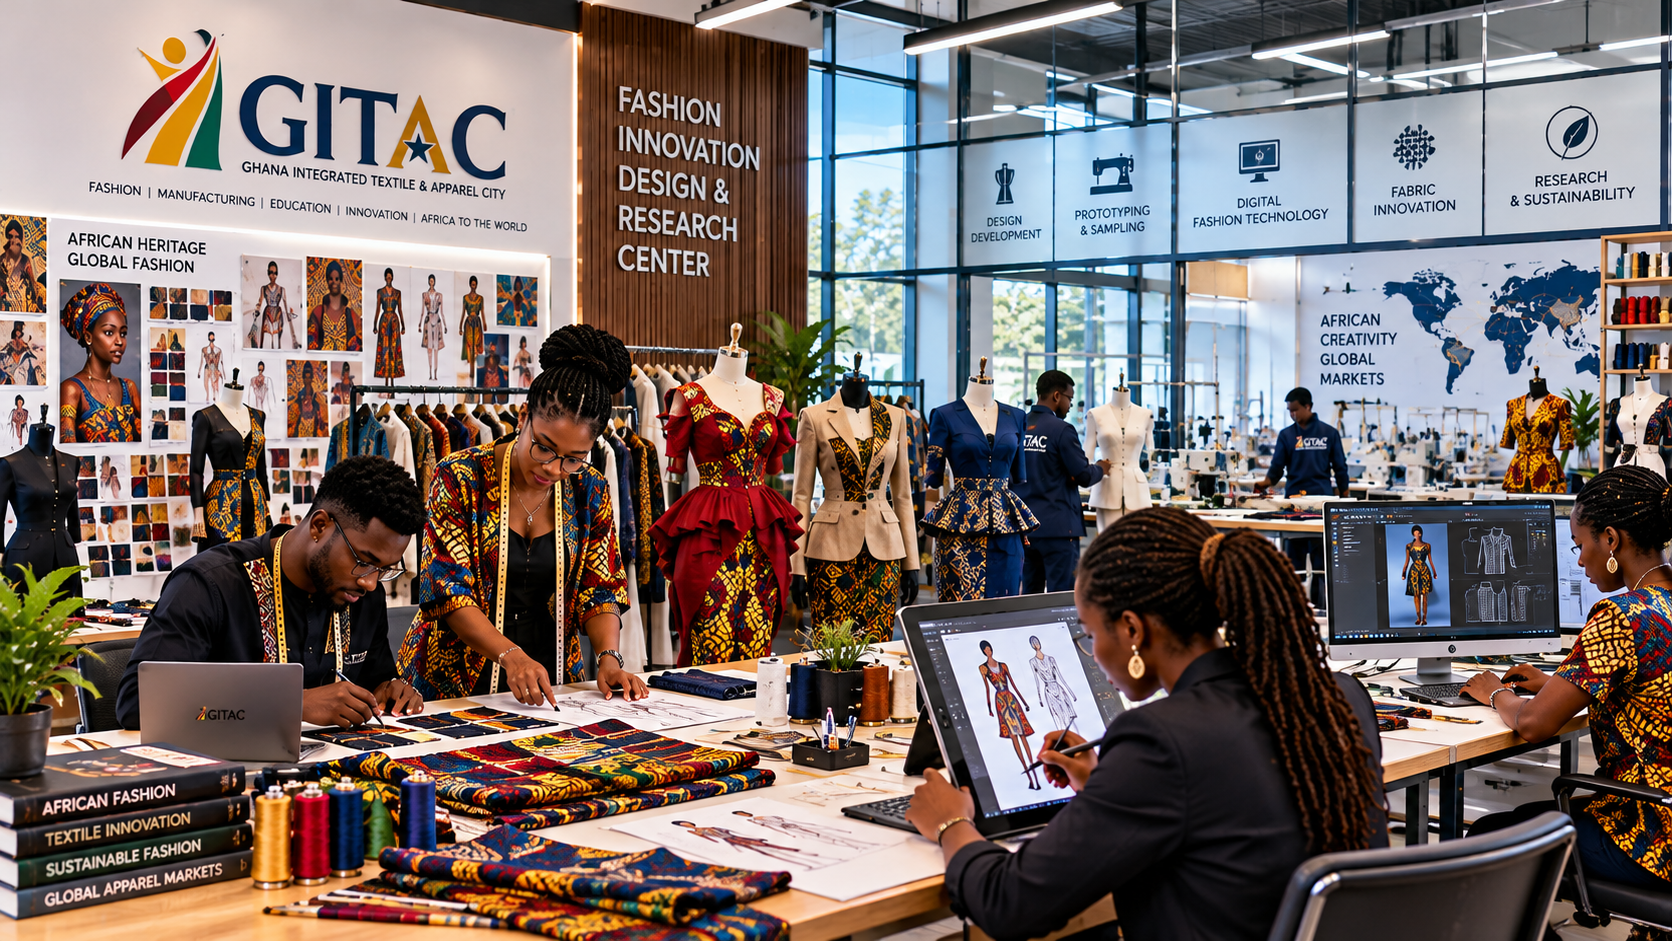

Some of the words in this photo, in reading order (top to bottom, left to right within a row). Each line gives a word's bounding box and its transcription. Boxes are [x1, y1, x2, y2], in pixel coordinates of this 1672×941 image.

[620, 86, 720, 127] FASHION
[239, 75, 506, 180] GITAC
[619, 126, 760, 171] INNOVATION
[242, 161, 289, 176] GHANA
[294, 167, 367, 185] INTEGRATED
[371, 175, 415, 190] TEXTILE
[419, 181, 427, 191] &
[431, 182, 478, 197] APPAREL
[482, 187, 505, 199] CITY
[620, 165, 706, 200] DESIGN
[714, 178, 729, 204] &
[1536, 171, 1607, 187] RESEARCH
[1392, 184, 1435, 197] FABRIC
[1511, 195, 1519, 206] &
[1524, 187, 1635, 206] SUSTAINABILITY
[89, 182, 141, 195] FASHION
[158, 189, 255, 206] MANUFACTURING
[271, 199, 331, 213] EDUCATION
[346, 207, 407, 220] INNOVATION
[421, 214, 455, 225] AFRICA
[459, 217, 471, 226] TO
[474, 219, 491, 229] THE
[494, 221, 527, 232] WORLD
[1238, 196, 1281, 208] DIGITAL
[1374, 200, 1455, 215] INNOVATION
[987, 216, 1021, 227] DESIGN
[1075, 205, 1150, 220] PROTOTYPING
[1194, 215, 1242, 227] FASHION
[1246, 208, 1328, 224] TECHNOLOGY
[619, 205, 737, 242] RESEARCH
[1081, 225, 1087, 235] &
[1091, 221, 1145, 235] SAMPLING
[68, 232, 132, 249] AFRICAN
[138, 237, 206, 255] HERITAGE
[971, 229, 1041, 243] DEVELOPMENT
[68, 253, 127, 269] GLOBAL
[133, 257, 194, 273] FASHION
[618, 245, 709, 276] CENTER
[1321, 314, 1380, 327] AFRICAN
[1321, 333, 1397, 346] CREATIVITY
[1320, 353, 1375, 365] GLOBAL
[1321, 373, 1384, 385] MARKETS
[208, 710, 245, 720] GITAC
[43, 793, 108, 815] AFRICAN
[113, 784, 175, 805] FASHION
[45, 825, 101, 846] TEXTILE
[105, 812, 190, 837] INNOVATION
[46, 849, 139, 877] SUSTAINABLE
[144, 839, 201, 860] FASHION
[45, 885, 100, 906] GLOBAL
[104, 875, 161, 896] APPAREL
[165, 863, 222, 885] MARKETS
